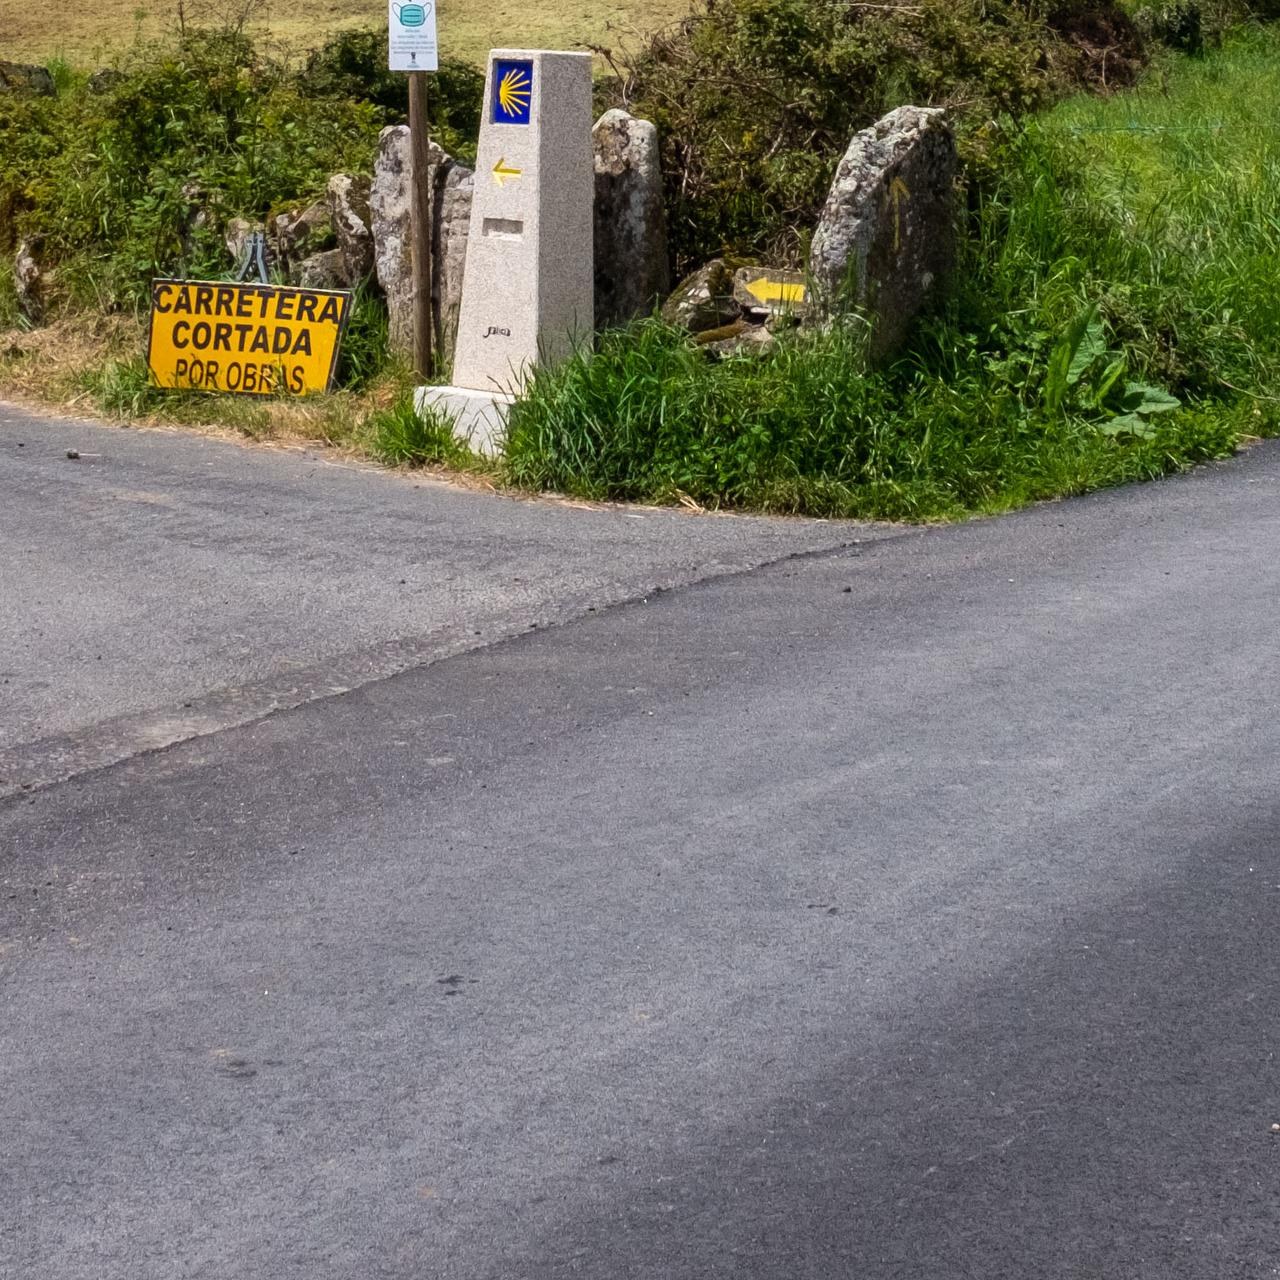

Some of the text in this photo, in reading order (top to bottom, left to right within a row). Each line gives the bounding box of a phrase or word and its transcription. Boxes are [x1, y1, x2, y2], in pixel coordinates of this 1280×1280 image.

[154, 285, 339, 324] CARRETERA
[172, 321, 312, 356] CORTADA
[176, 359, 219, 389] POR
